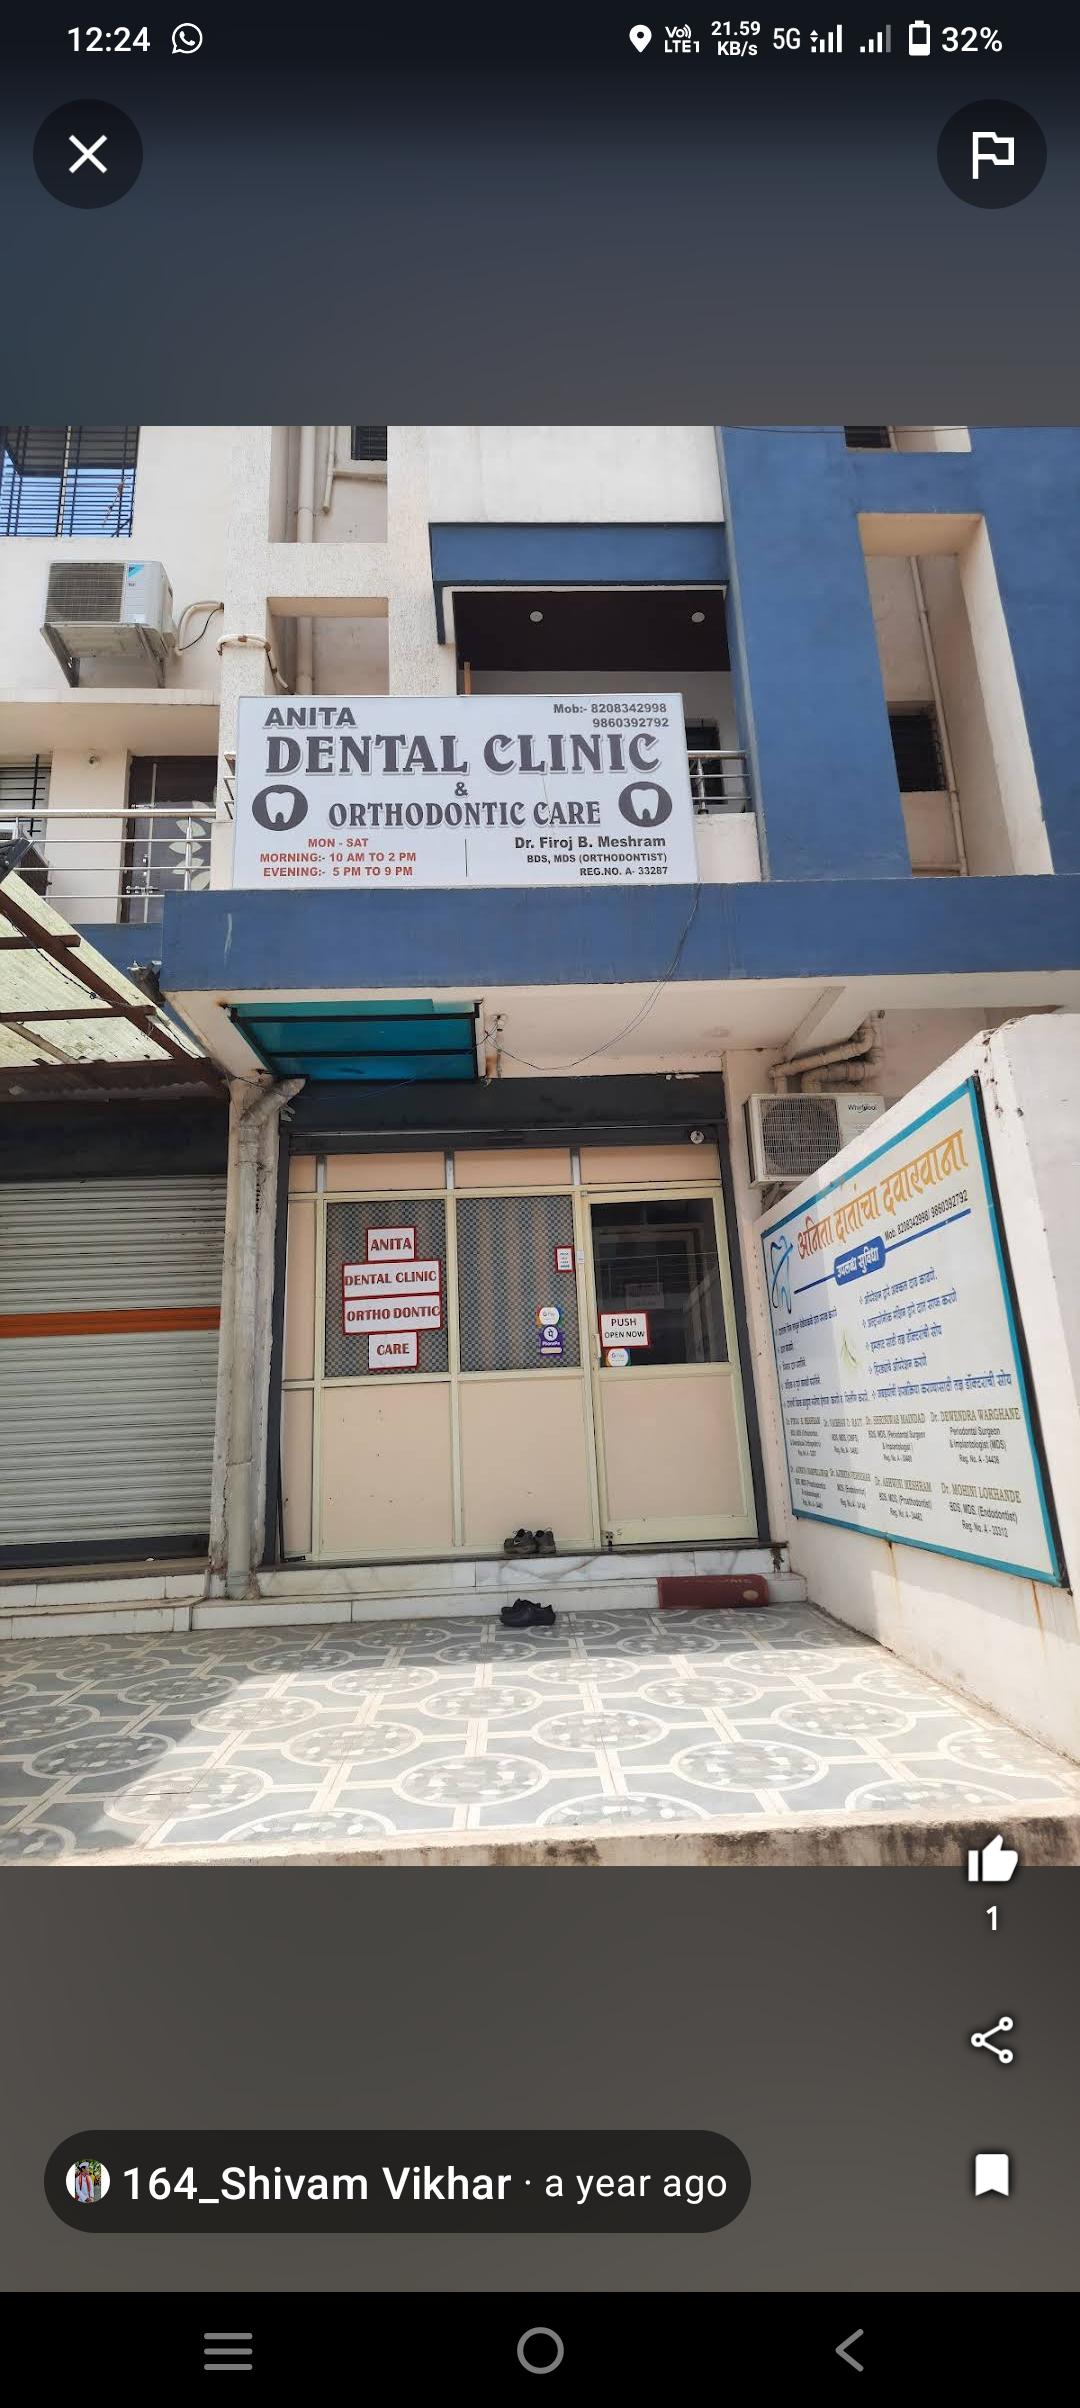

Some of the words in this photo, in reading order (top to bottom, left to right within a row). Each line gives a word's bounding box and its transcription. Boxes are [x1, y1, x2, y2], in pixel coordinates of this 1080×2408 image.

[553, 704, 587, 714] Mob:-
[591, 703, 666, 714] 8208342998
[264, 707, 357, 727] ANITA
[592, 718, 669, 728] 9860392792
[266, 735, 469, 774] DENTAL
[484, 733, 660, 772] CLINIC
[454, 781, 468, 796] &
[329, 802, 525, 828] ORTHODONTIC
[534, 801, 600, 825] CARE
[308, 838, 334, 848] MON
[346, 838, 369, 848] SAT
[515, 837, 534, 848] Dr.
[540, 836, 573, 851] Firoj
[578, 837, 591, 848] B.
[597, 836, 666, 847] Meshram
[260, 852, 325, 863] MORNING:-
[330, 852, 343, 862] 10
[347, 852, 365, 862] AM
[369, 852, 384, 862] TO
[388, 851, 395, 862] 2
[400, 851, 416, 862] PM
[527, 854, 550, 865] BDS,
[554, 854, 575, 863] MDS
[578, 853, 667, 864] (ORTHODONTIST)
[263, 866, 325, 877] EVENING:-
[332, 866, 340, 877] 5
[343, 866, 361, 877] PM
[365, 866, 381, 877] TO
[384, 866, 392, 876] 9
[395, 866, 413, 876] PM
[580, 867, 621, 876] REG.NO.
[638, 866, 668, 875] 33287
[797, 1216, 832, 1259] अनिता
[833, 1184, 879, 1242] दातांचा
[371, 1237, 412, 1251] ANITA
[345, 1272, 392, 1287] DENTAL
[396, 1269, 437, 1284] CLINIC
[347, 1308, 389, 1323] ORTHO
[393, 1305, 440, 1320] DONTIC
[611, 1317, 637, 1327] PUSH
[605, 1330, 624, 1339] OPEN
[626, 1329, 645, 1339] NOW
[377, 1343, 410, 1356] CARE
